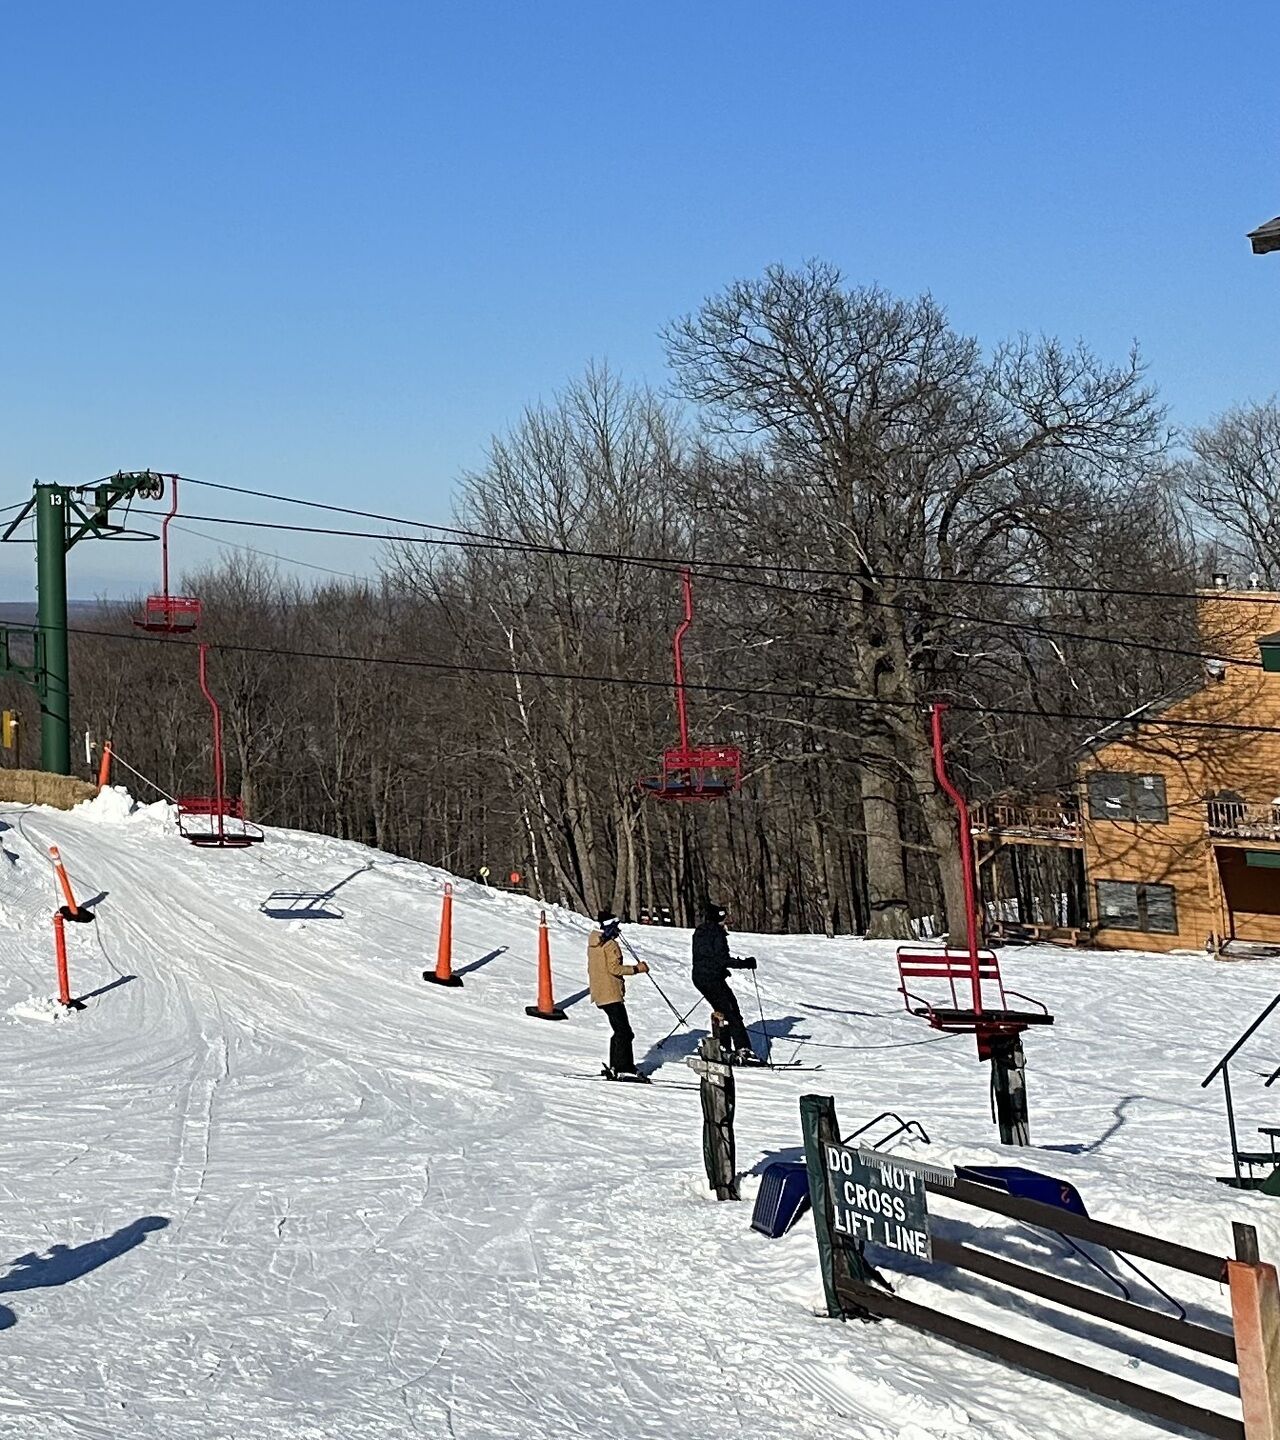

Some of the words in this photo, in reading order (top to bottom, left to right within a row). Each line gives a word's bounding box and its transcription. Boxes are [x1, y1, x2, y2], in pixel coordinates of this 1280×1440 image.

[50, 493, 62, 506] 13
[828, 1147, 853, 1176] DO
[880, 1161, 916, 1195] NOT
[843, 1181, 906, 1222] CROSS
[834, 1205, 875, 1241] LIFT
[884, 1221, 928, 1258] LINE
